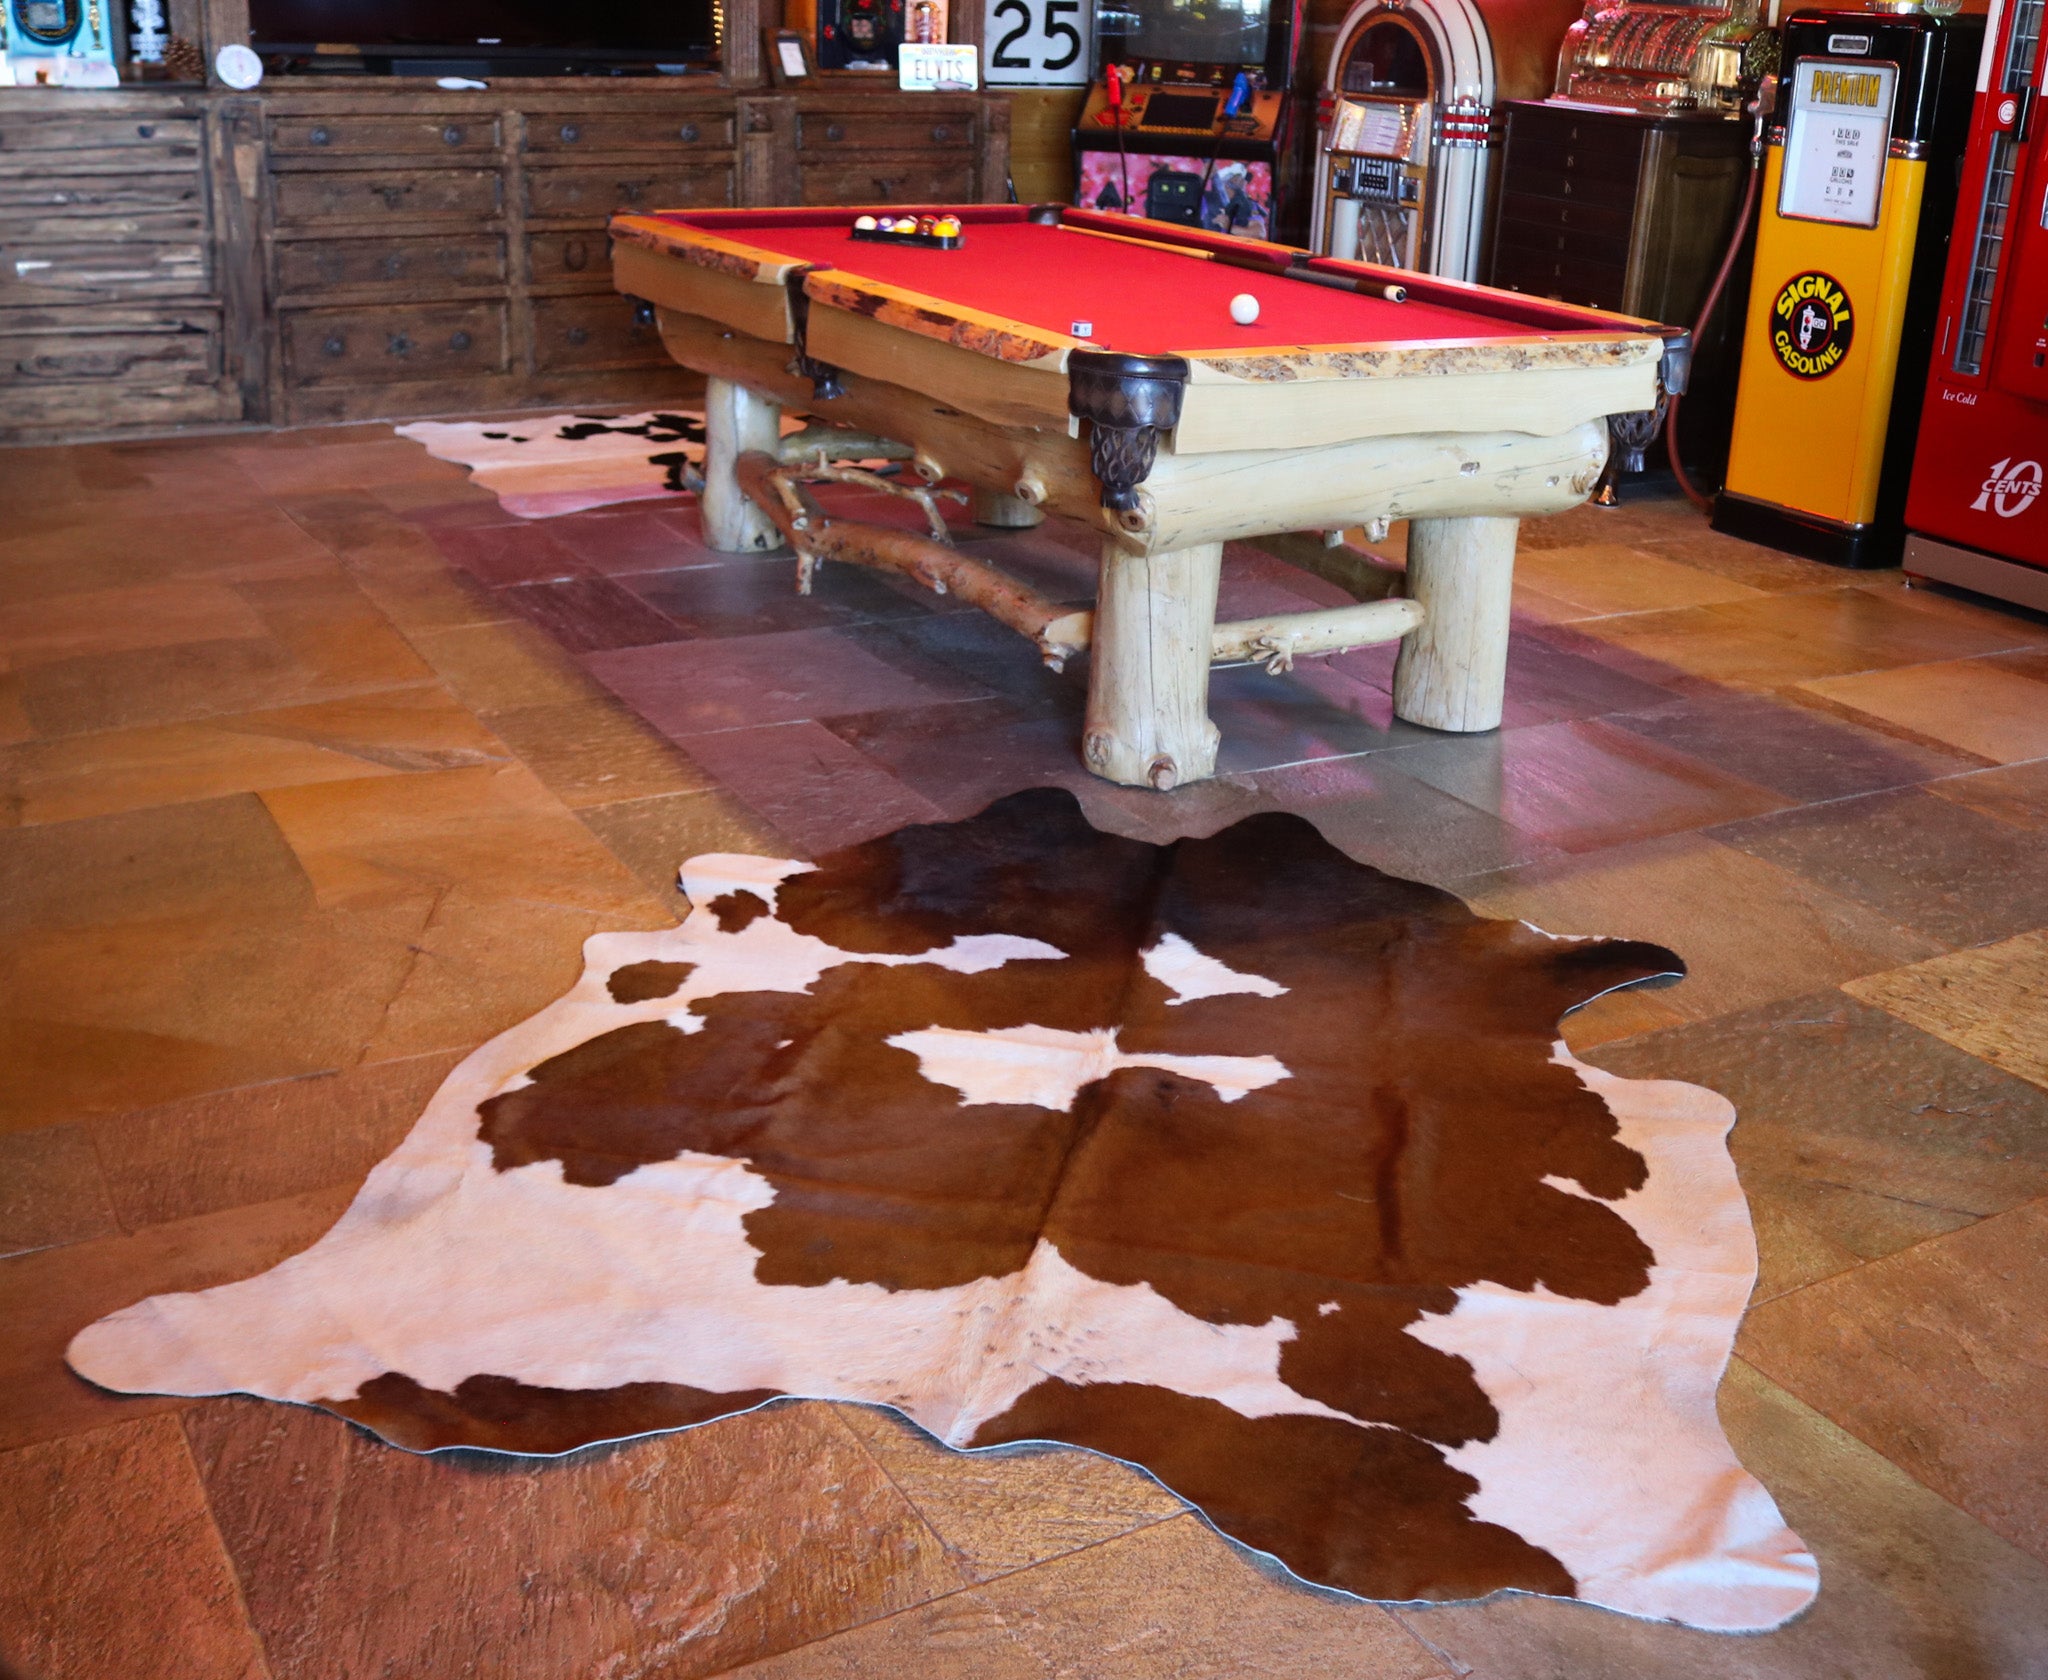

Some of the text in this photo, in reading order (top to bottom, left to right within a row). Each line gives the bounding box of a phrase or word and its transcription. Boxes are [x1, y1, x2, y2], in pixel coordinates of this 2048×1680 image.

[992, 0, 1081, 70] 25
[914, 59, 964, 81] ELVIS
[1811, 70, 1881, 107] PREMIUM
[1776, 275, 1850, 331] SIGNAL
[1775, 330, 1843, 374] GASOLINE
[1942, 389, 1977, 406] Ice Cold
[1970, 457, 2043, 518] 10
[1981, 478, 2043, 497] CENTS
